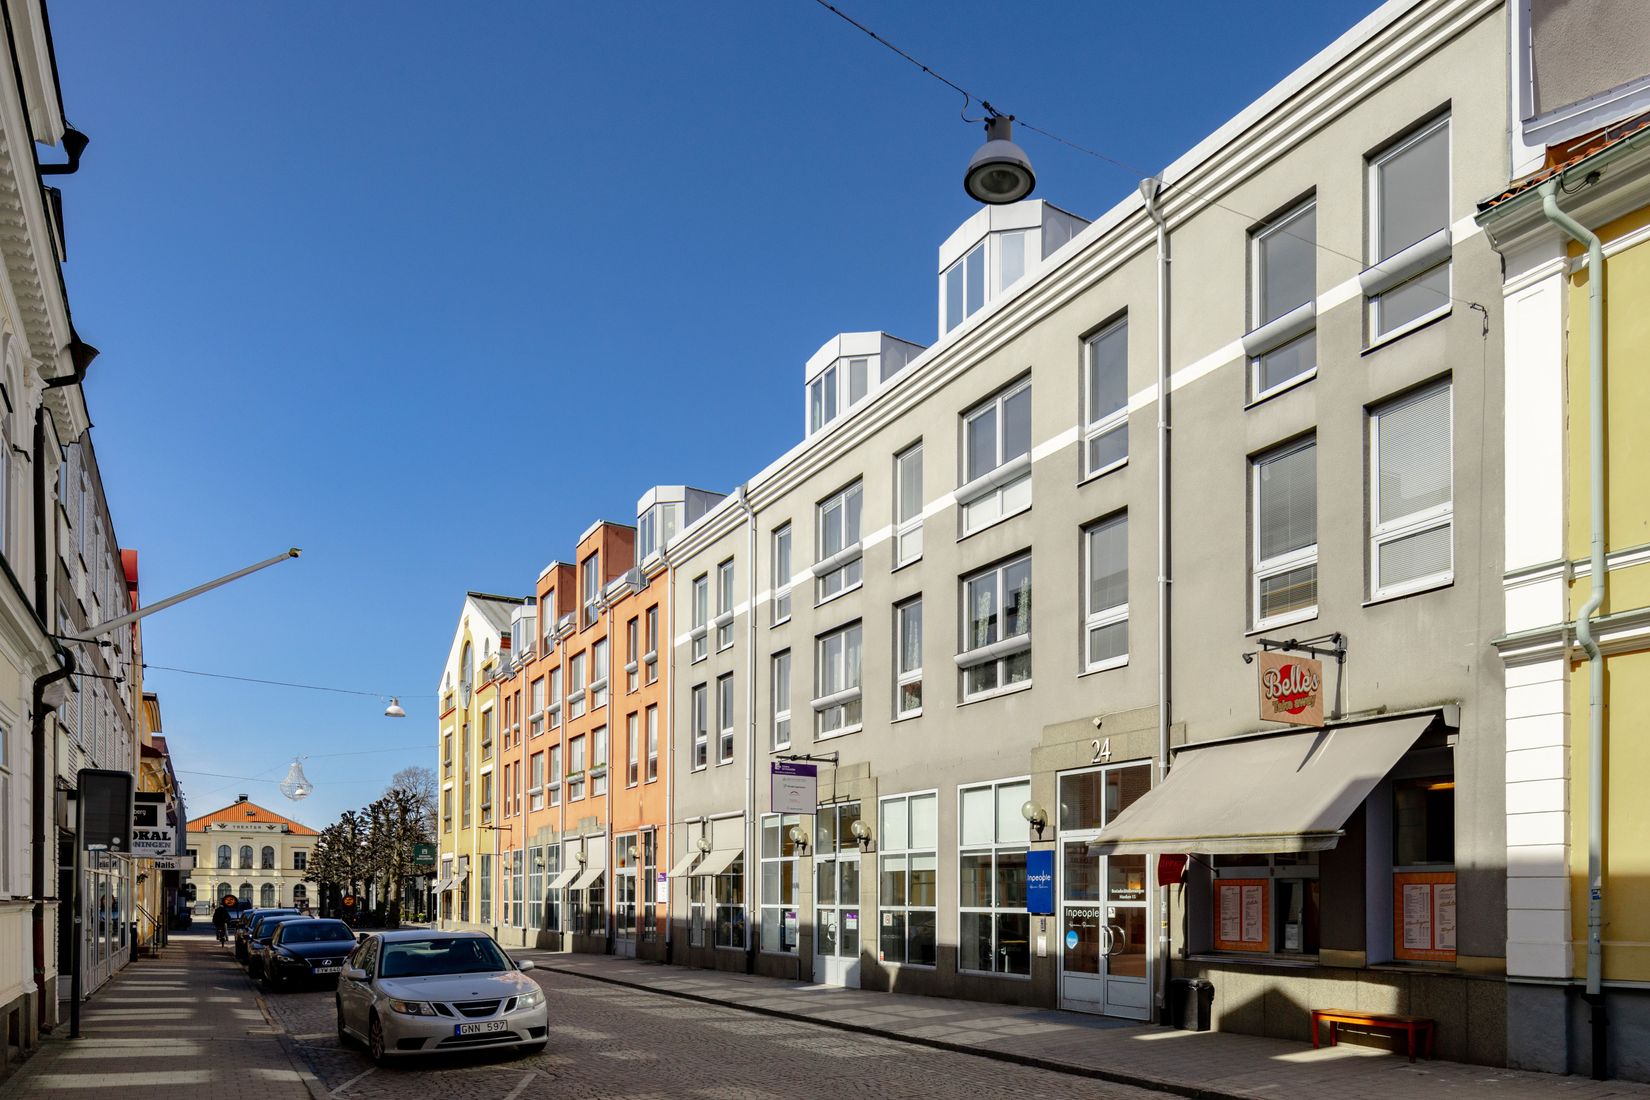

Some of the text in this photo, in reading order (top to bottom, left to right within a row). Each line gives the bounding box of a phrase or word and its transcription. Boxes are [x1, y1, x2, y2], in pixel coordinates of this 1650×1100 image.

[1263, 665, 1320, 699] Belle's
[1091, 737, 1112, 764] 24
[1027, 871, 1051, 884] Inpeople
[1065, 908, 1100, 919] Inpeople
[461, 1021, 505, 1034] GNN 597
